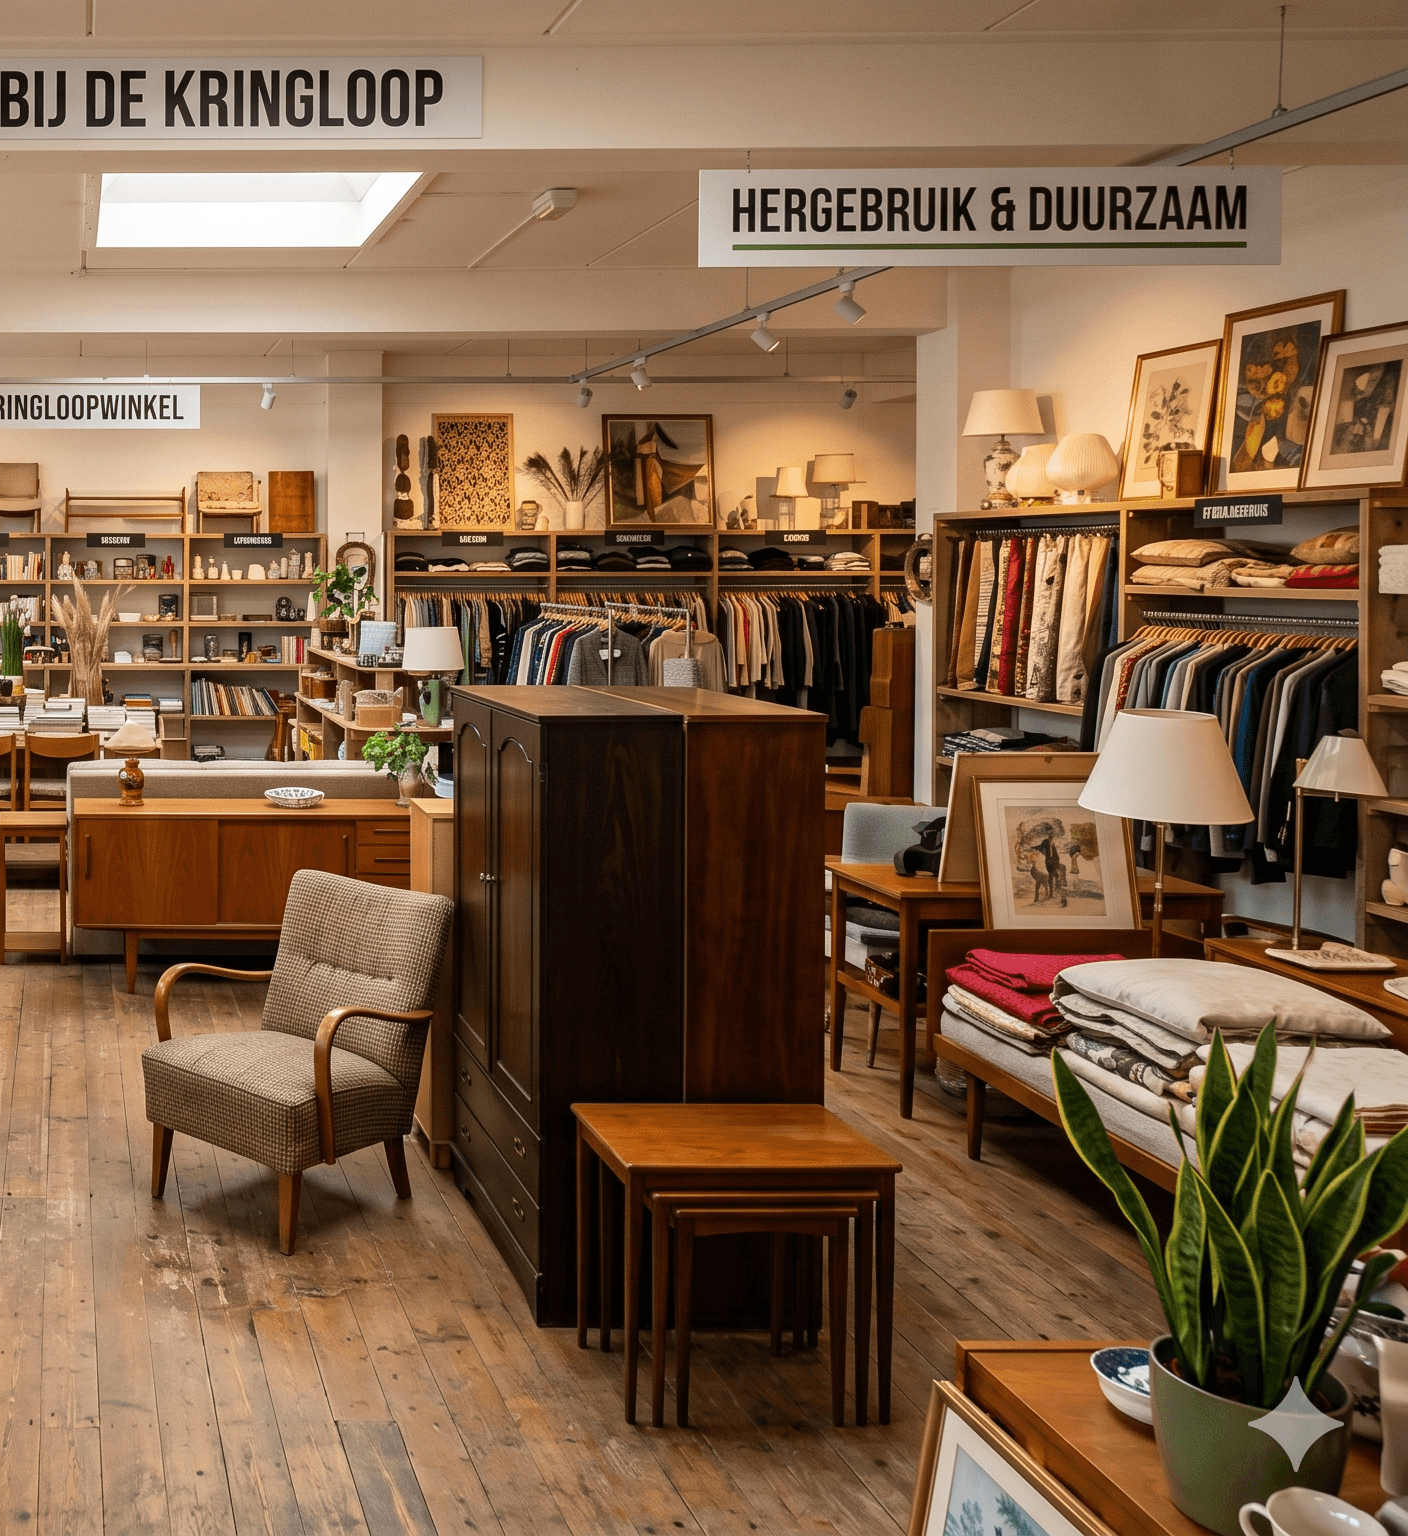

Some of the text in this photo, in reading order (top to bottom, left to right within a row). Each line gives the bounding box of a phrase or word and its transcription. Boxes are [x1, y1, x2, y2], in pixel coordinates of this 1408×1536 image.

[0, 69, 68, 129] BIJ
[85, 69, 148, 128] DE
[164, 69, 444, 128] KRINGLOOP
[731, 184, 1249, 233] HERGEBRUIK & DUURZAAM
